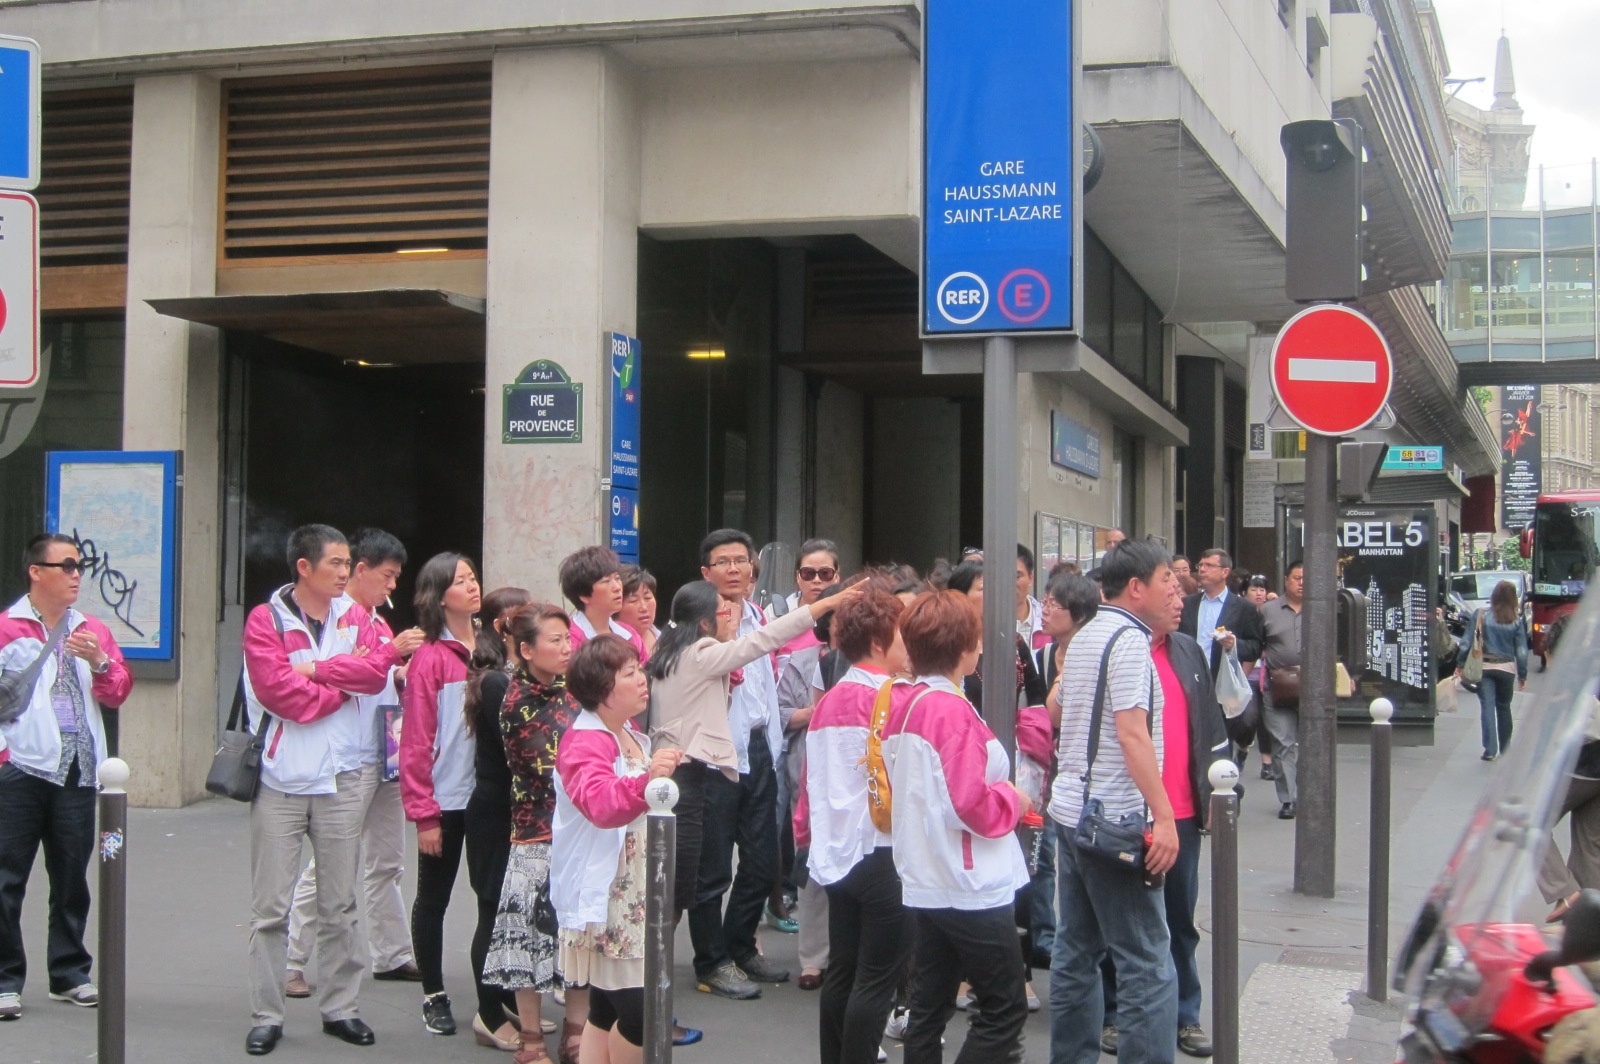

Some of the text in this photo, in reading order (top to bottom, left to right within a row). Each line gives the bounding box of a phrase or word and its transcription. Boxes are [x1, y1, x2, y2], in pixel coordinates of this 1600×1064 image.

[980, 160, 1024, 176] GARE
[944, 182, 1056, 202] HAUSSMANN
[944, 204, 1062, 224] SAINT-LAZARE
[946, 289, 980, 306] RER
[1015, 284, 1032, 306] E
[612, 338, 627, 358] RER
[530, 394, 554, 406] RUE
[509, 420, 574, 432] PROVENCE
[1562, 585, 1569, 595] 3
[1372, 630, 1381, 657] 5
[1401, 647, 1421, 656] LABEL
[1386, 648, 1392, 658] 5
[1407, 666, 1414, 686] 5
